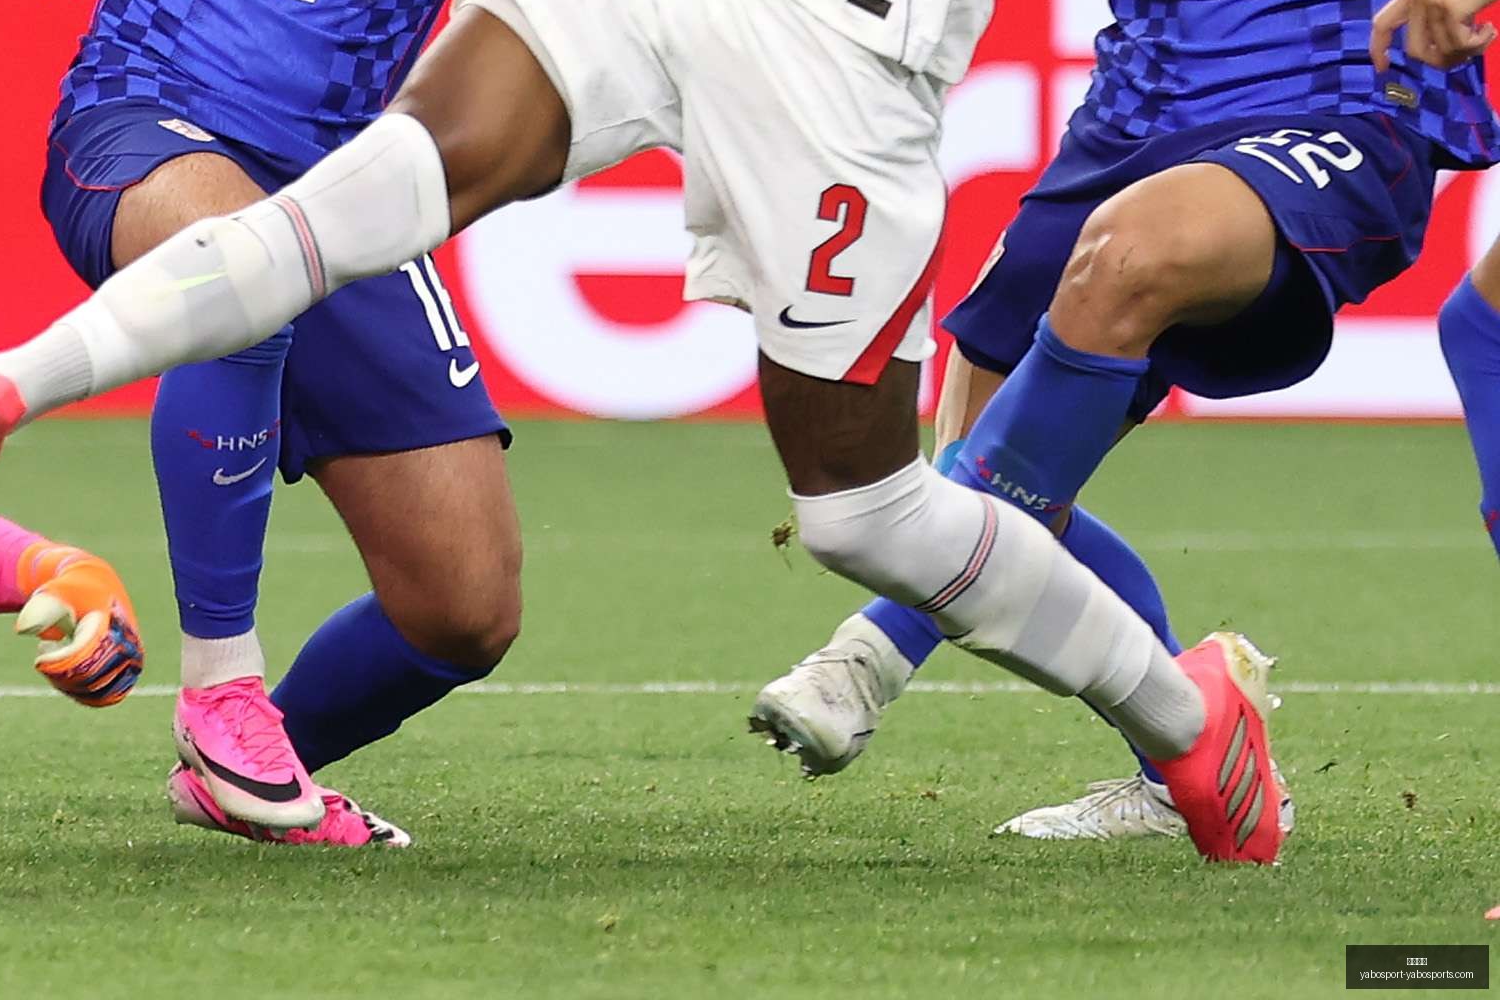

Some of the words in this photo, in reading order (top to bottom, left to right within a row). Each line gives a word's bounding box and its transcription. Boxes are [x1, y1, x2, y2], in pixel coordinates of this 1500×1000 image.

[805, 183, 870, 297] 2
[216, 428, 268, 451] HNS
[990, 472, 1051, 511] HNS
